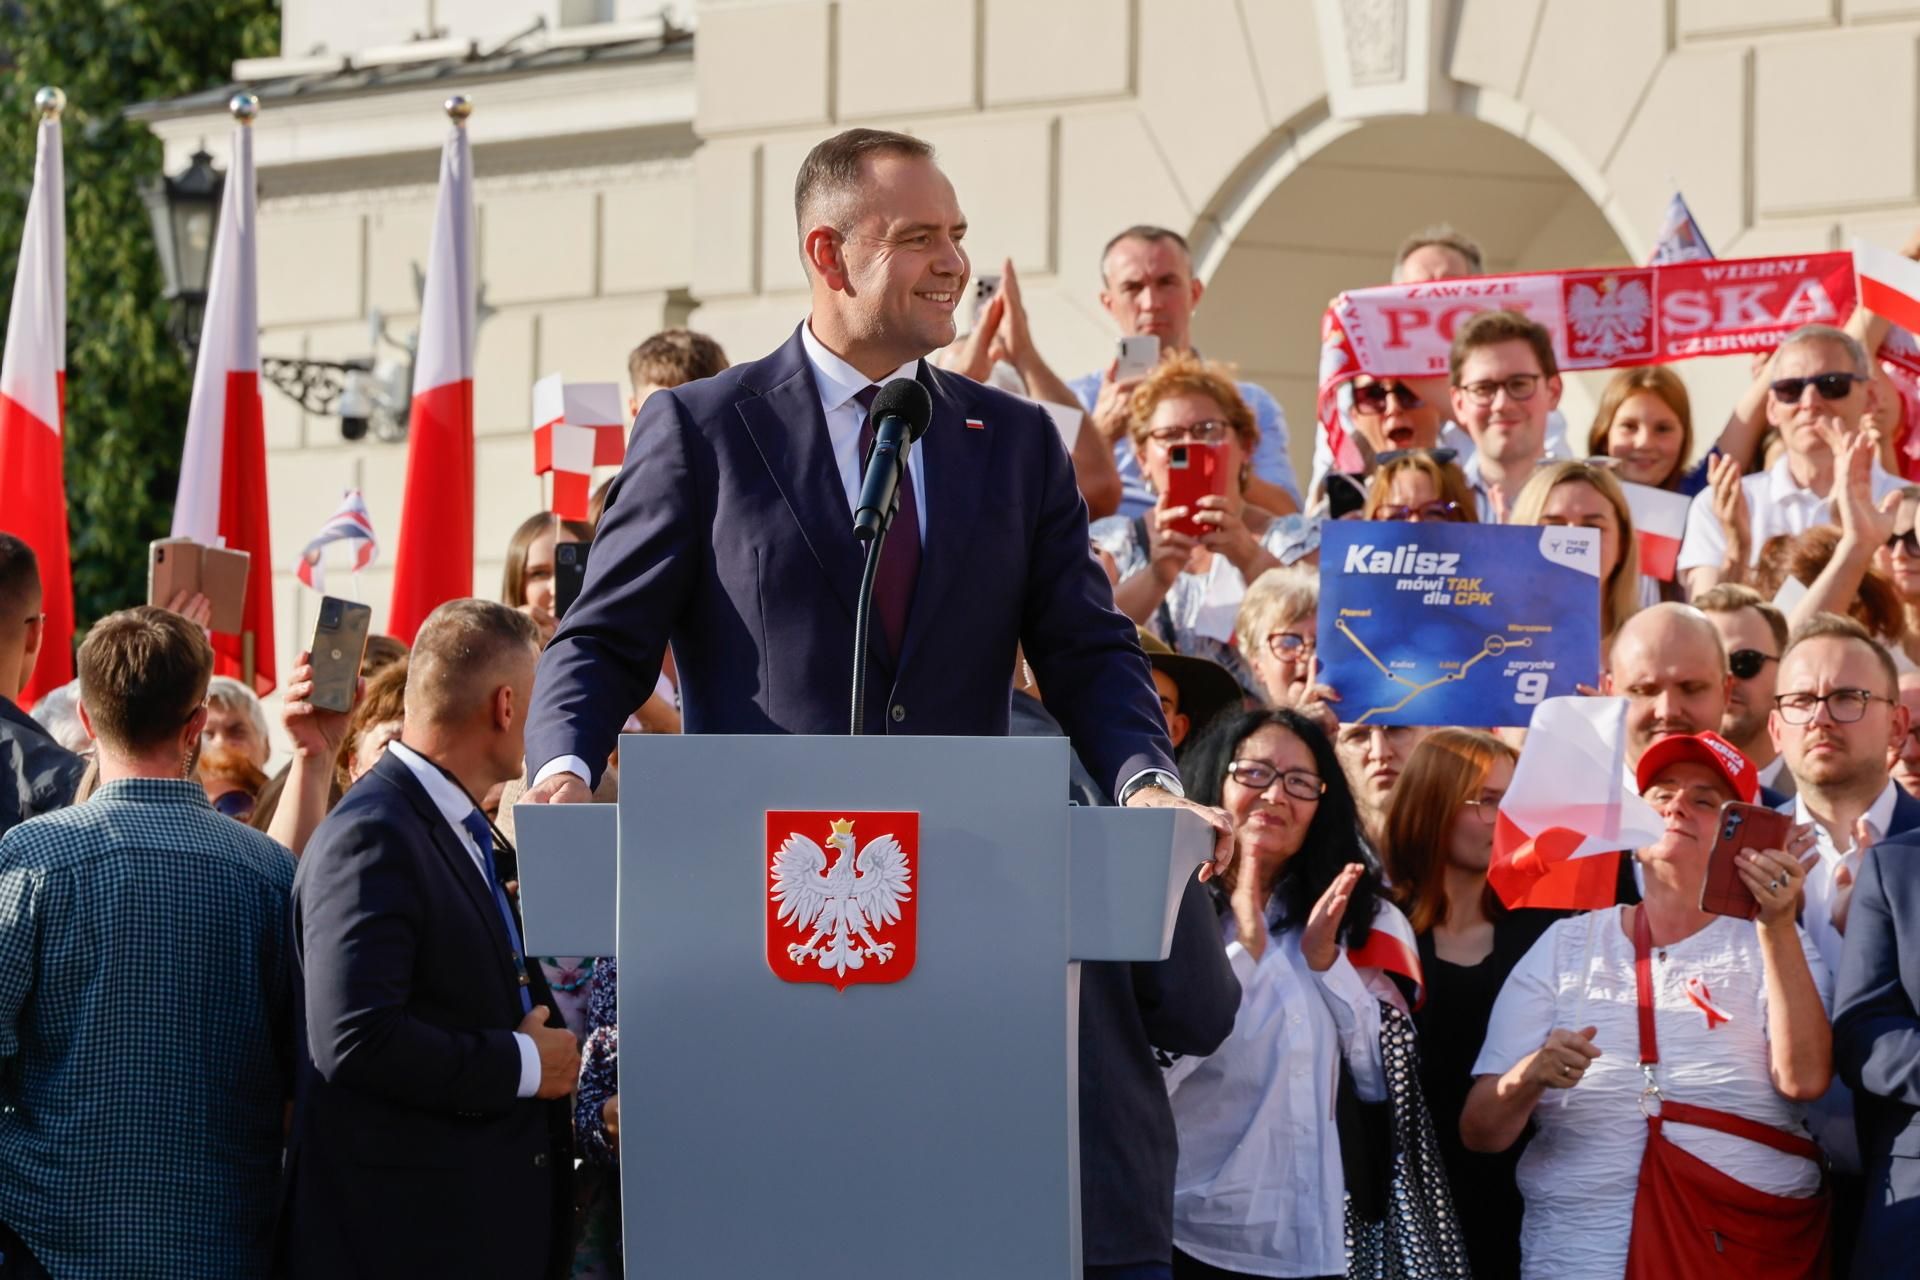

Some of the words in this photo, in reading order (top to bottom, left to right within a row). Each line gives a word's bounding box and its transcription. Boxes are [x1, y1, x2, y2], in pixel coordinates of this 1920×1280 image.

[1407, 283, 1520, 299] ZAWSZE
[1702, 259, 1809, 281] WIERNI
[1661, 277, 1838, 336] SKA
[1344, 544, 1460, 575] Kalisz
[1396, 576, 1445, 591] mówi
[1447, 578, 1482, 591] TAK
[1423, 592, 1452, 605] dla
[1454, 592, 1494, 605] CPK
[1514, 672, 1549, 704] 9
